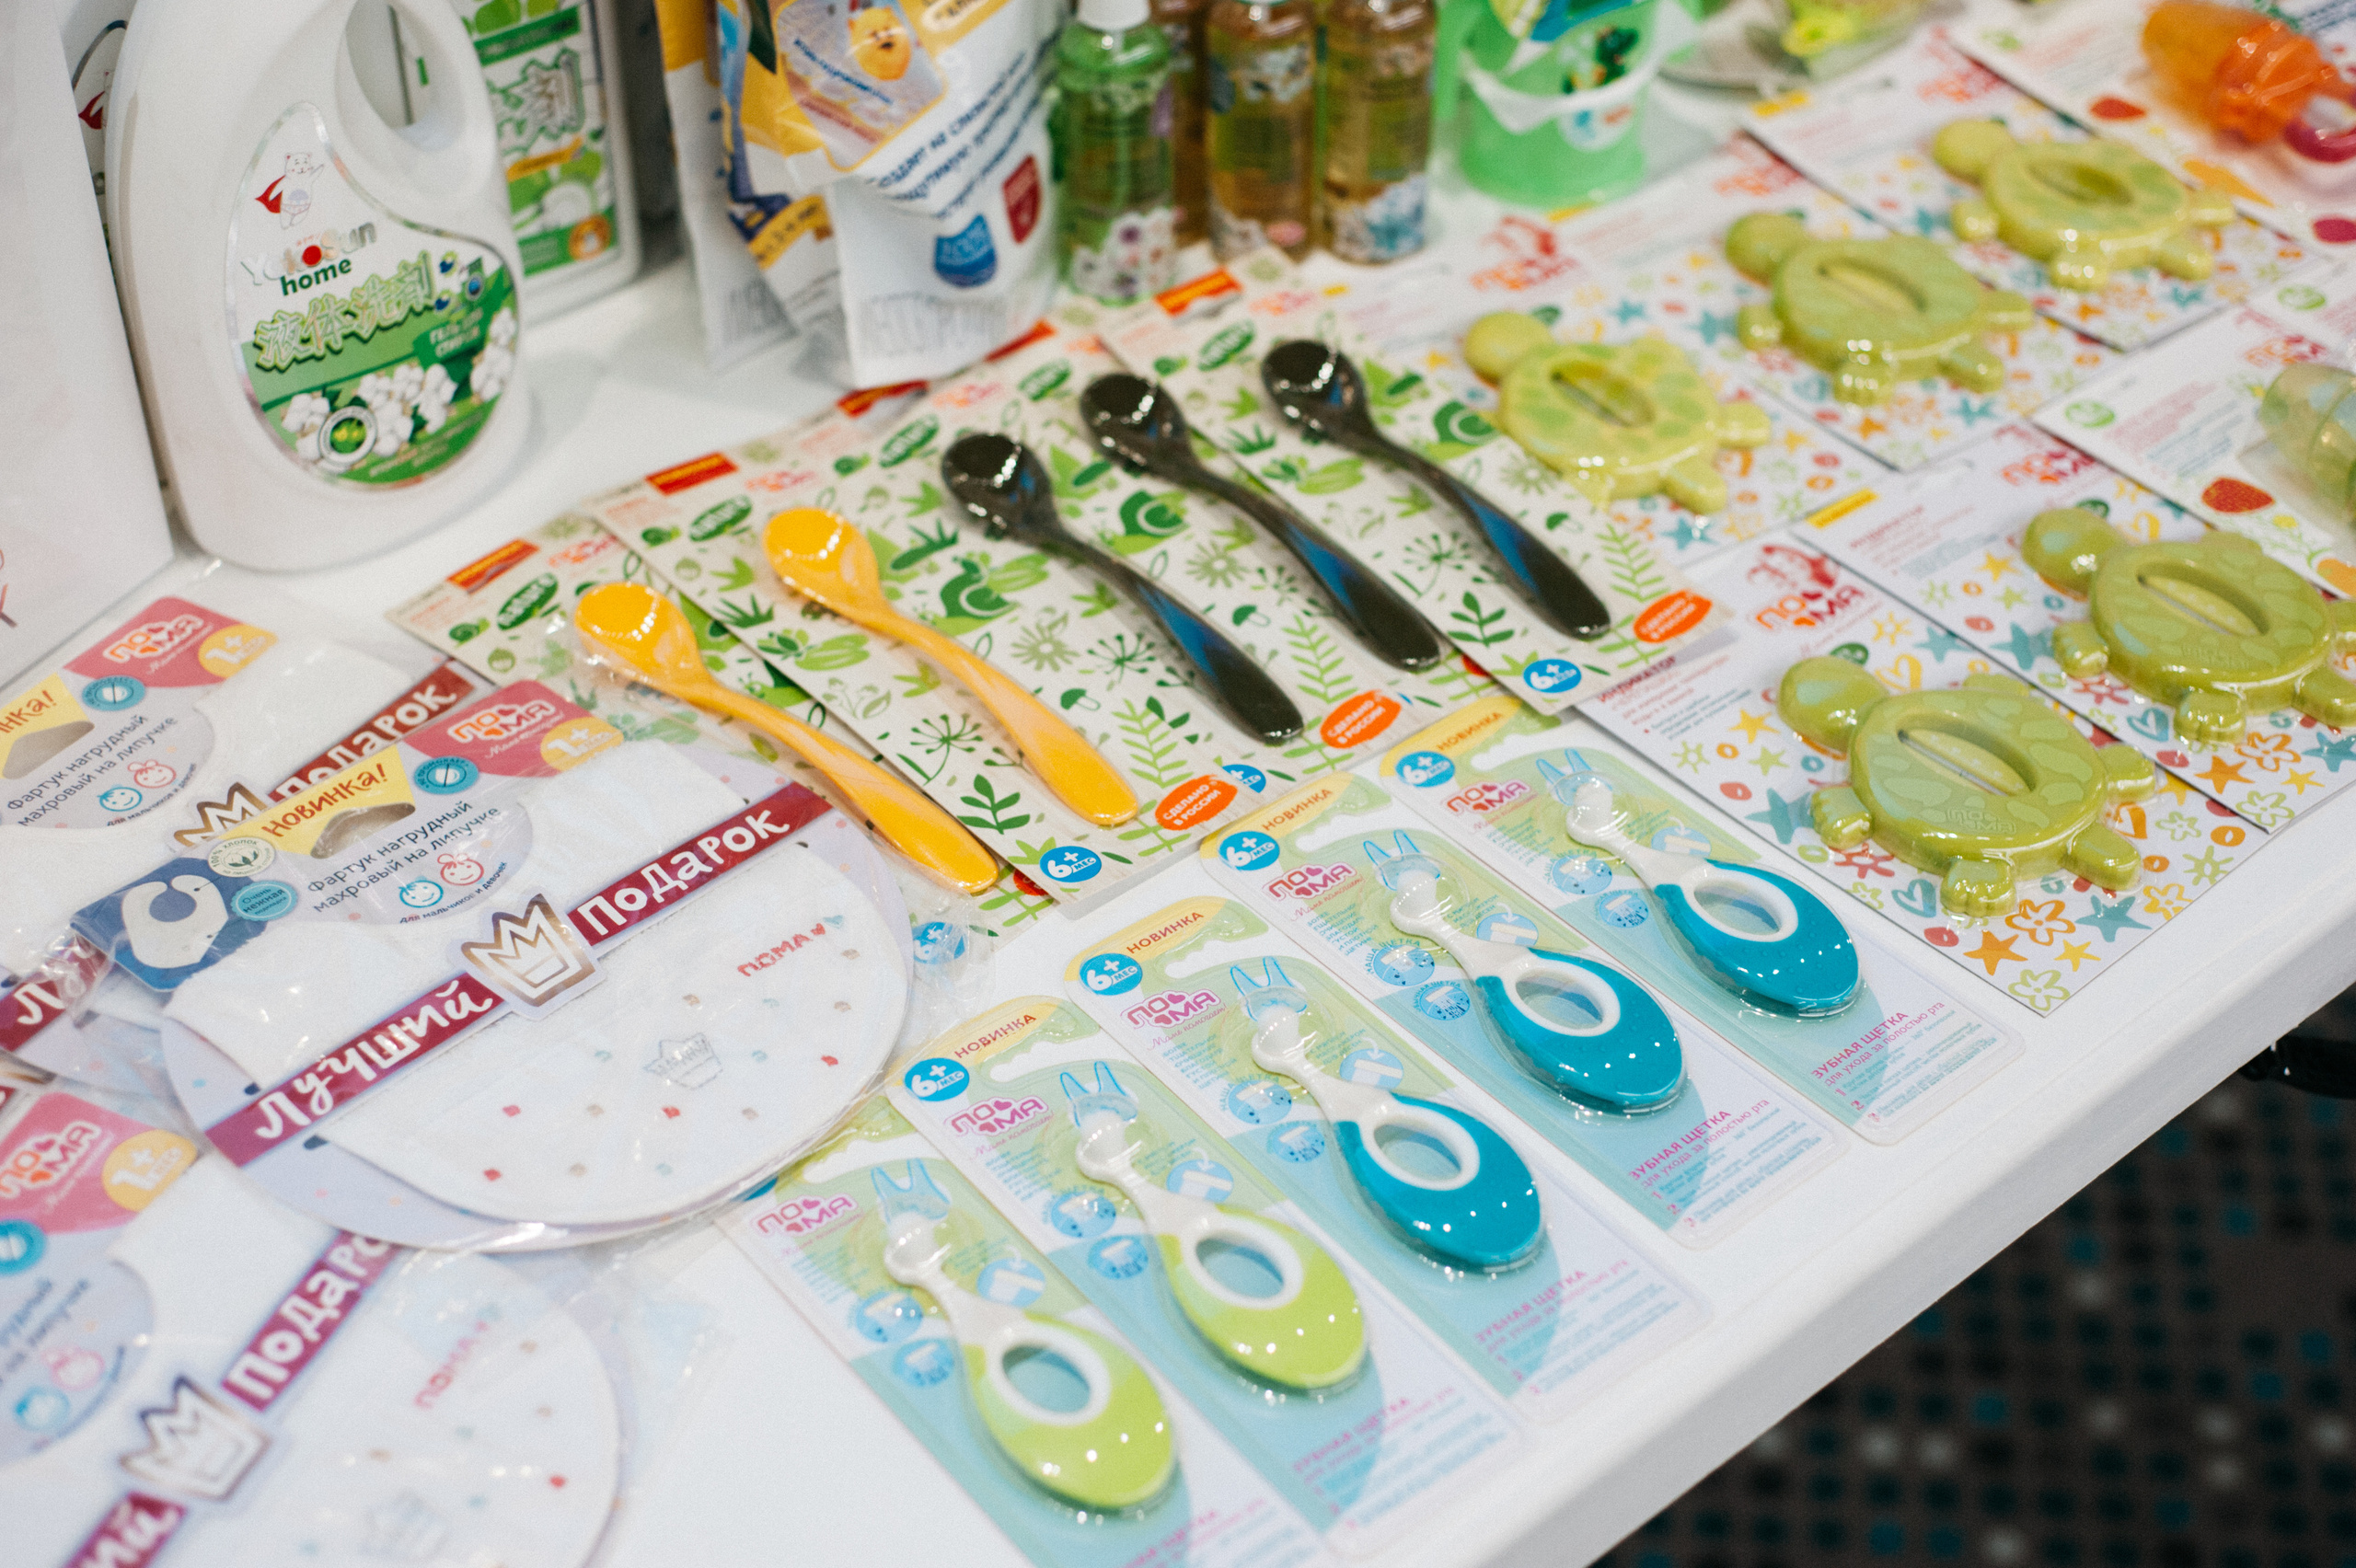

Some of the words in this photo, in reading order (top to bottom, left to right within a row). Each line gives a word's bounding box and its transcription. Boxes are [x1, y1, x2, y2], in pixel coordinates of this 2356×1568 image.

[280, 259, 352, 295] home
[1437, 711, 1502, 752] НОВИНКА
[7, 770, 68, 810] Фартук
[66, 714, 149, 771] нагрудный
[18, 771, 97, 826] махровый
[95, 760, 117, 775] на
[116, 717, 178, 761] липучке
[1163, 784, 1209, 820] СДЕЛАНО
[1173, 817, 1184, 826] В
[1182, 790, 1221, 821] РОССИИ
[1262, 788, 1333, 831] НОВИНКА
[1447, 781, 1530, 813] ПОМА
[308, 853, 378, 894] Фартук
[376, 801, 473, 857] нагрудный
[313, 859, 404, 913] махровый
[404, 847, 430, 864] на
[431, 807, 502, 851] липучке
[1047, 852, 1079, 879] 6+
[1073, 857, 1096, 871] МЕС
[1227, 836, 1257, 867] 6+
[1252, 841, 1276, 859] МЕС
[398, 914, 421, 924] для
[422, 893, 475, 918] мальчиков
[482, 861, 508, 891] девочек
[1268, 863, 1354, 899] ПОМА
[243, 889, 285, 913] нежная
[1126, 911, 1205, 954] НОВИНКА
[1086, 960, 1120, 991] 6+
[1114, 966, 1137, 982] МЕС
[1126, 991, 1218, 1026] ПОМА
[954, 1014, 1037, 1058] НОВИНКА
[1811, 1042, 1864, 1079] ЗУБНАЯ
[1860, 1012, 1909, 1044] ЩЕТКА
[1824, 1071, 1844, 1088] для
[1842, 1051, 1873, 1075] ухода
[1870, 1043, 1885, 1054] за
[1882, 1013, 1929, 1044] полостью
[1927, 1000, 1946, 1016] рта
[911, 1065, 946, 1097] 6+
[940, 1070, 964, 1088] МЕС
[951, 1099, 1044, 1133] ПОМА
[1628, 1141, 1682, 1181] ЗУБНАЯ
[1680, 1110, 1731, 1146] ЩЕТКА
[756, 1197, 853, 1234] ПОМА
